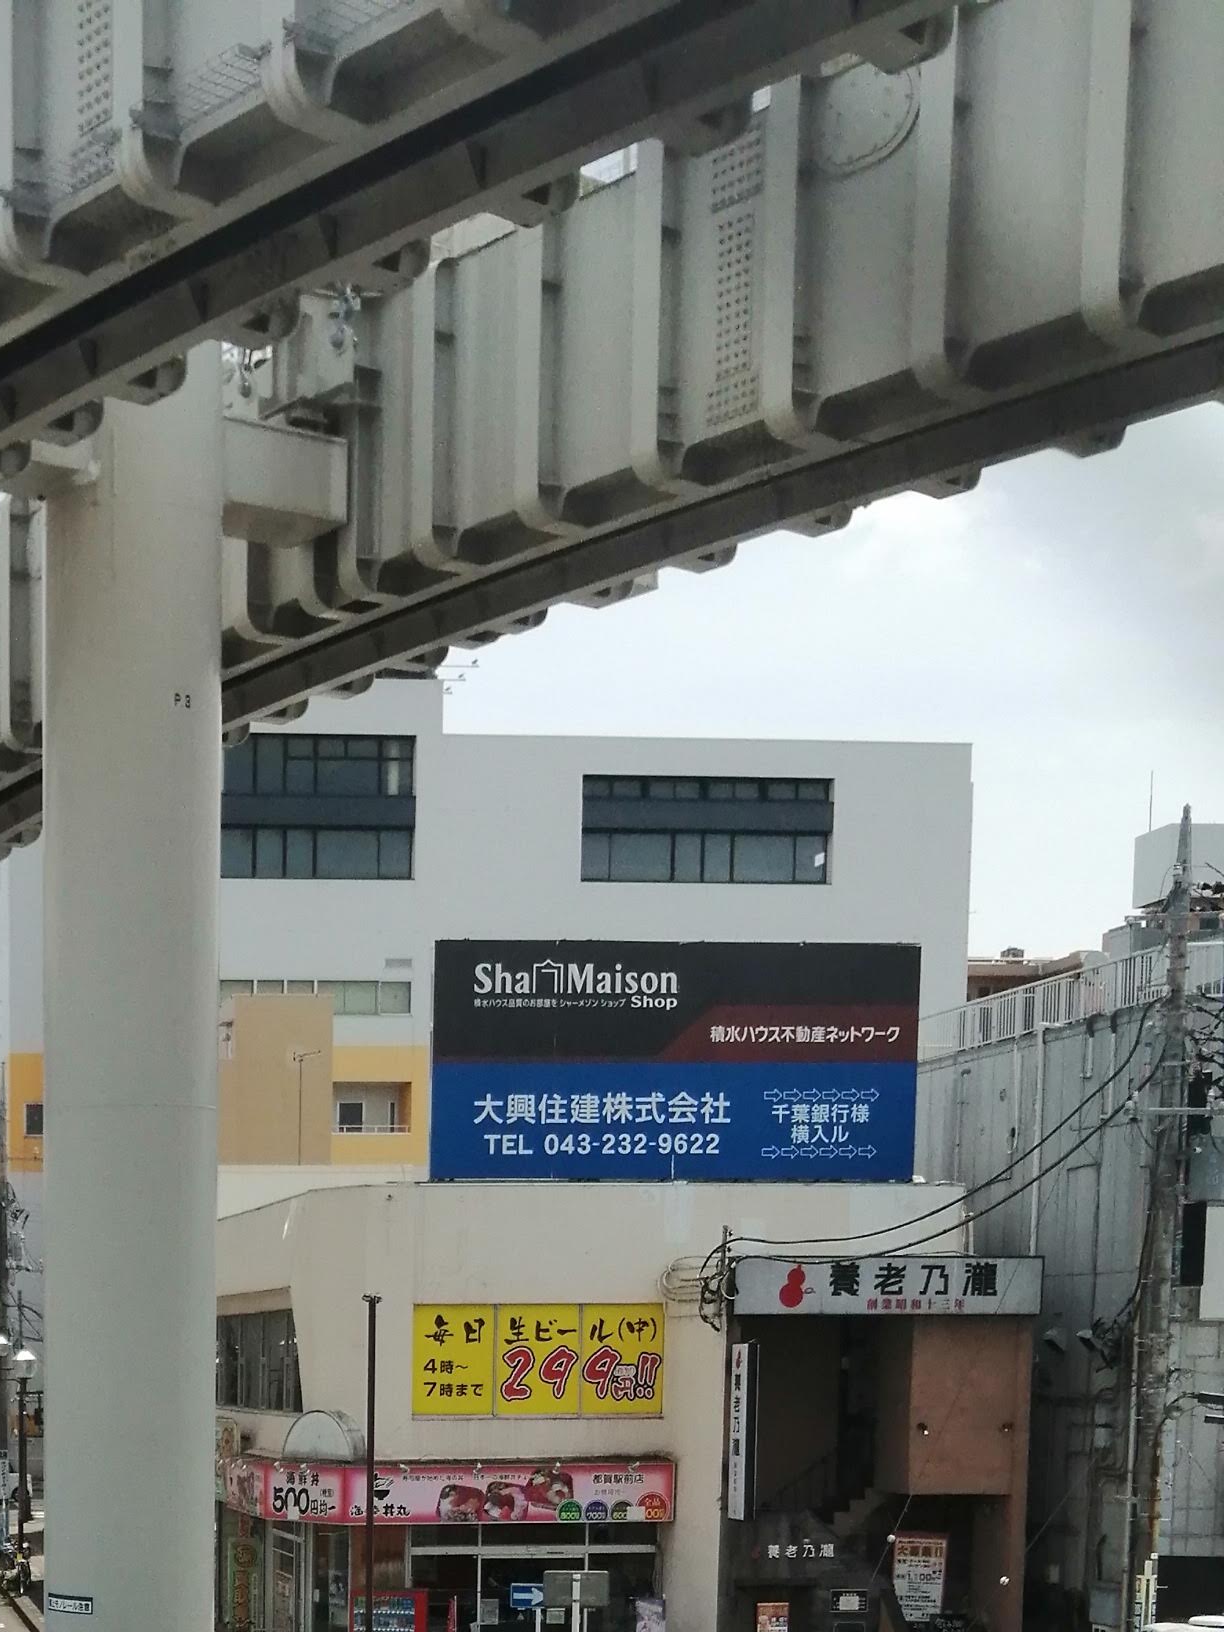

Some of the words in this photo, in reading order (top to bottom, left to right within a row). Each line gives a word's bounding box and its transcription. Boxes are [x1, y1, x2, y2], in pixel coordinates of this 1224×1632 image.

[630, 995, 678, 1011] Shop
[710, 1026, 900, 1043] 積水ハウス不動産ネットワーク
[473, 1092, 731, 1124] 大興住建株式会社
[771, 1104, 870, 1124] 千葉銀行様
[790, 1125, 849, 1144] 横入ル
[483, 1134, 534, 1155] TEL
[544, 1134, 720, 1155] 043-232-9622
[829, 1262, 998, 1297] 養老乃瀧
[866, 1298, 966, 1312] 創業昭和十三年
[424, 1314, 485, 1346] 毎日
[423, 1381, 484, 1398] 7時まで
[286, 1471, 320, 1486] 海鮮丼
[592, 1474, 644, 1484] 都賀駅前店
[767, 1544, 835, 1558] 養老乃瀧
